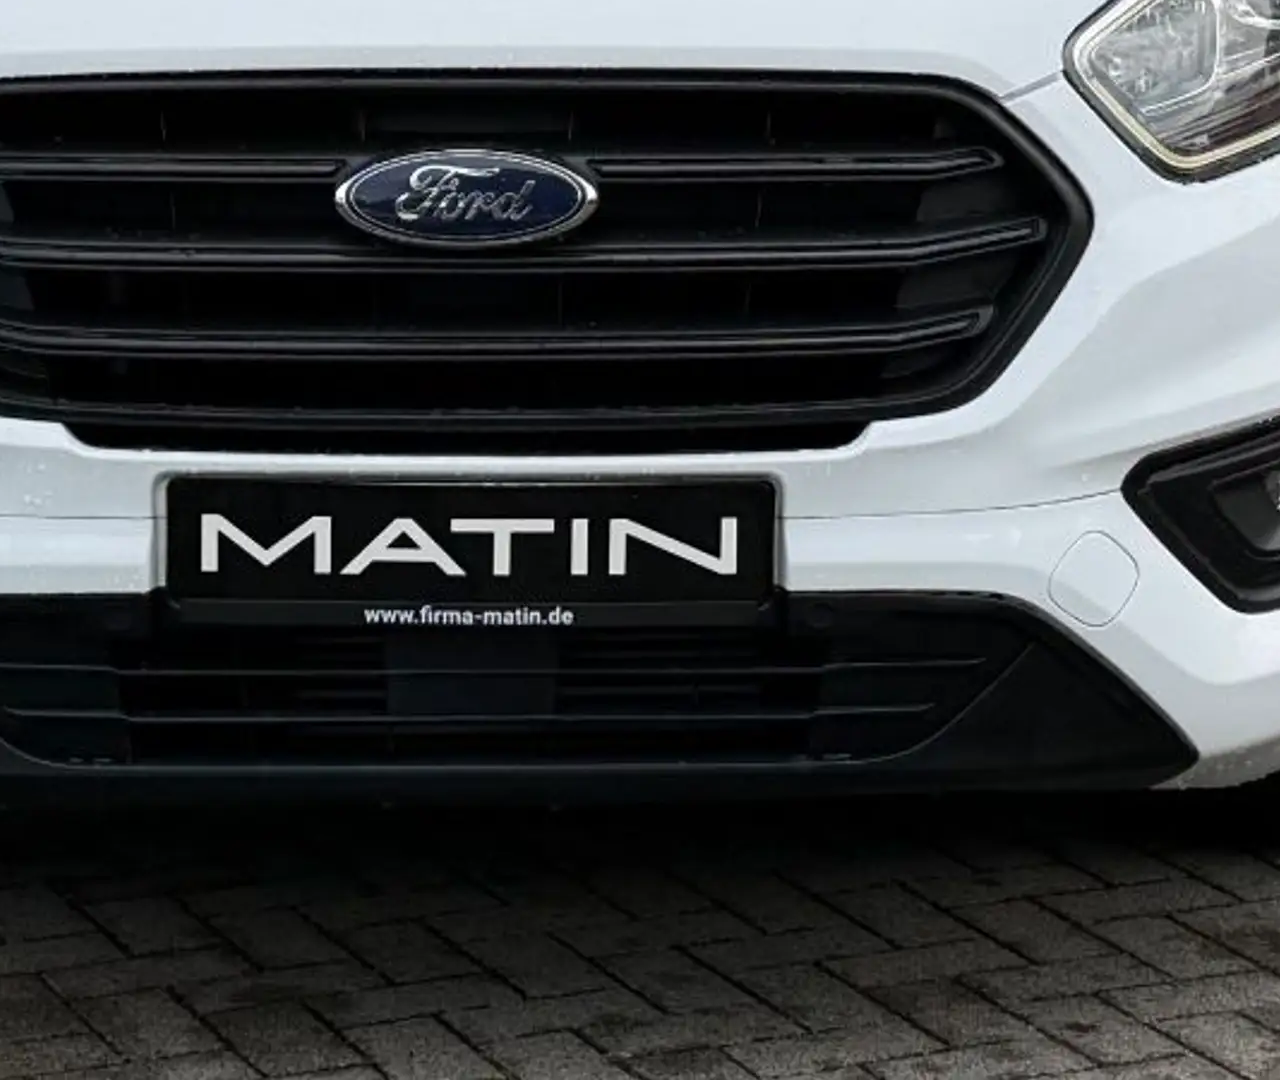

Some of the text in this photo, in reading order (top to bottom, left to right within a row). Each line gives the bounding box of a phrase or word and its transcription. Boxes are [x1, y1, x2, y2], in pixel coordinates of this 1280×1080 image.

[395, 164, 536, 221] Ford
[200, 513, 737, 576] MATIN
[364, 604, 575, 626] www.firma-matin.de
